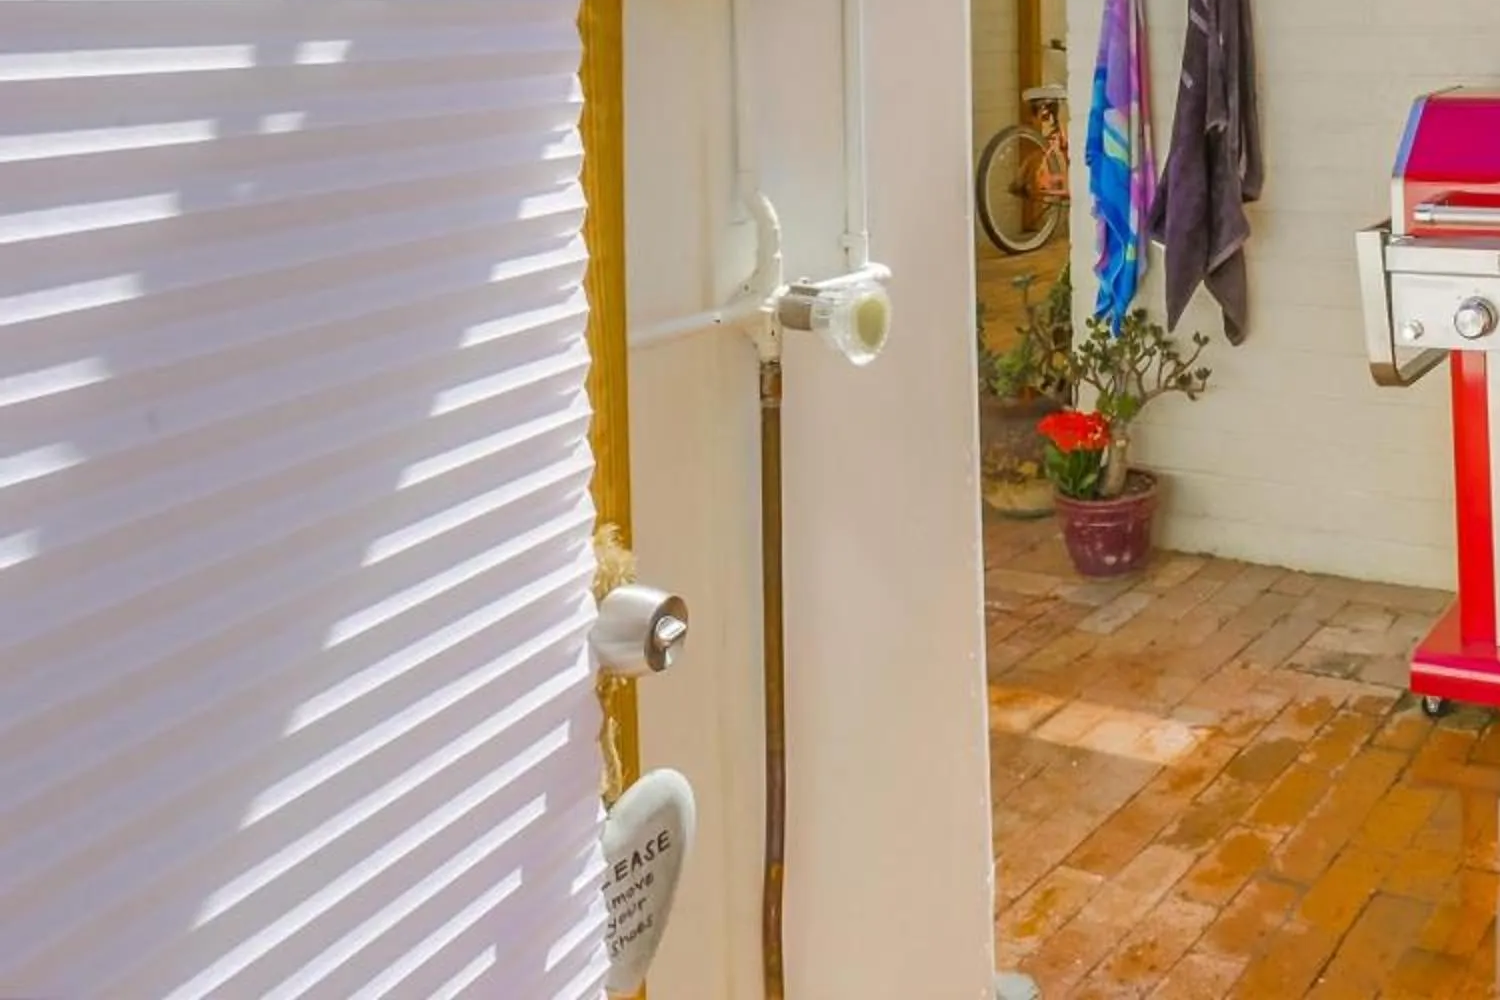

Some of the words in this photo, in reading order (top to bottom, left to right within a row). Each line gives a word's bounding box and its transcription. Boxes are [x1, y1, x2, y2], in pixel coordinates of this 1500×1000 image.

[600, 829, 671, 892] EASE
[605, 871, 655, 914] move
[607, 896, 648, 939] your
[610, 912, 654, 958] shoes
